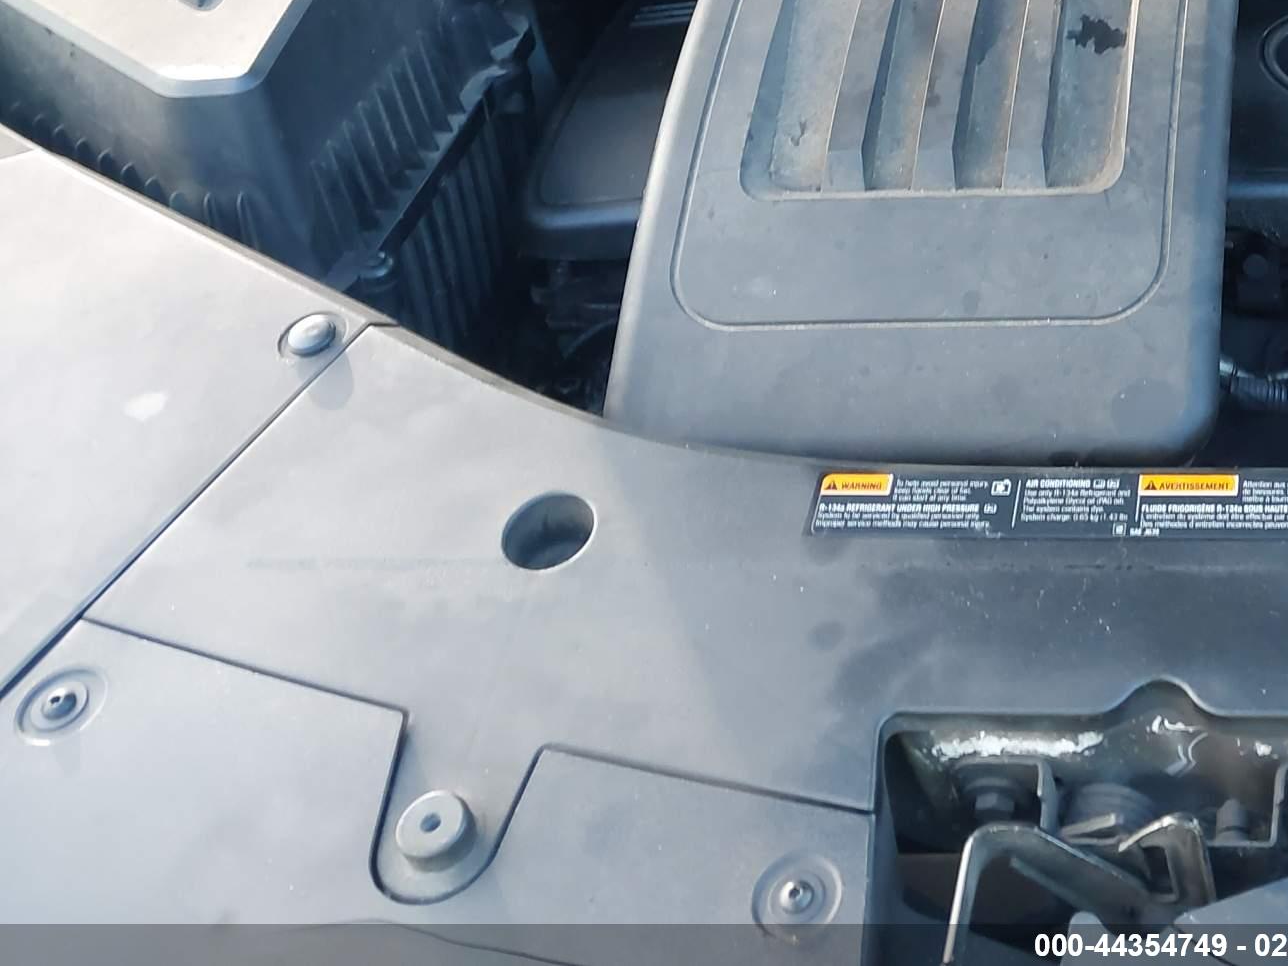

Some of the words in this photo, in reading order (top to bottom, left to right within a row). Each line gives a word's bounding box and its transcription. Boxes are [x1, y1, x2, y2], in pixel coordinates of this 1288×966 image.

[841, 481, 882, 490] WARNING
[1026, 479, 1039, 488] AIR
[1040, 479, 1091, 488] CONDITIONING
[1160, 482, 1229, 490] AVERTISSEMENT
